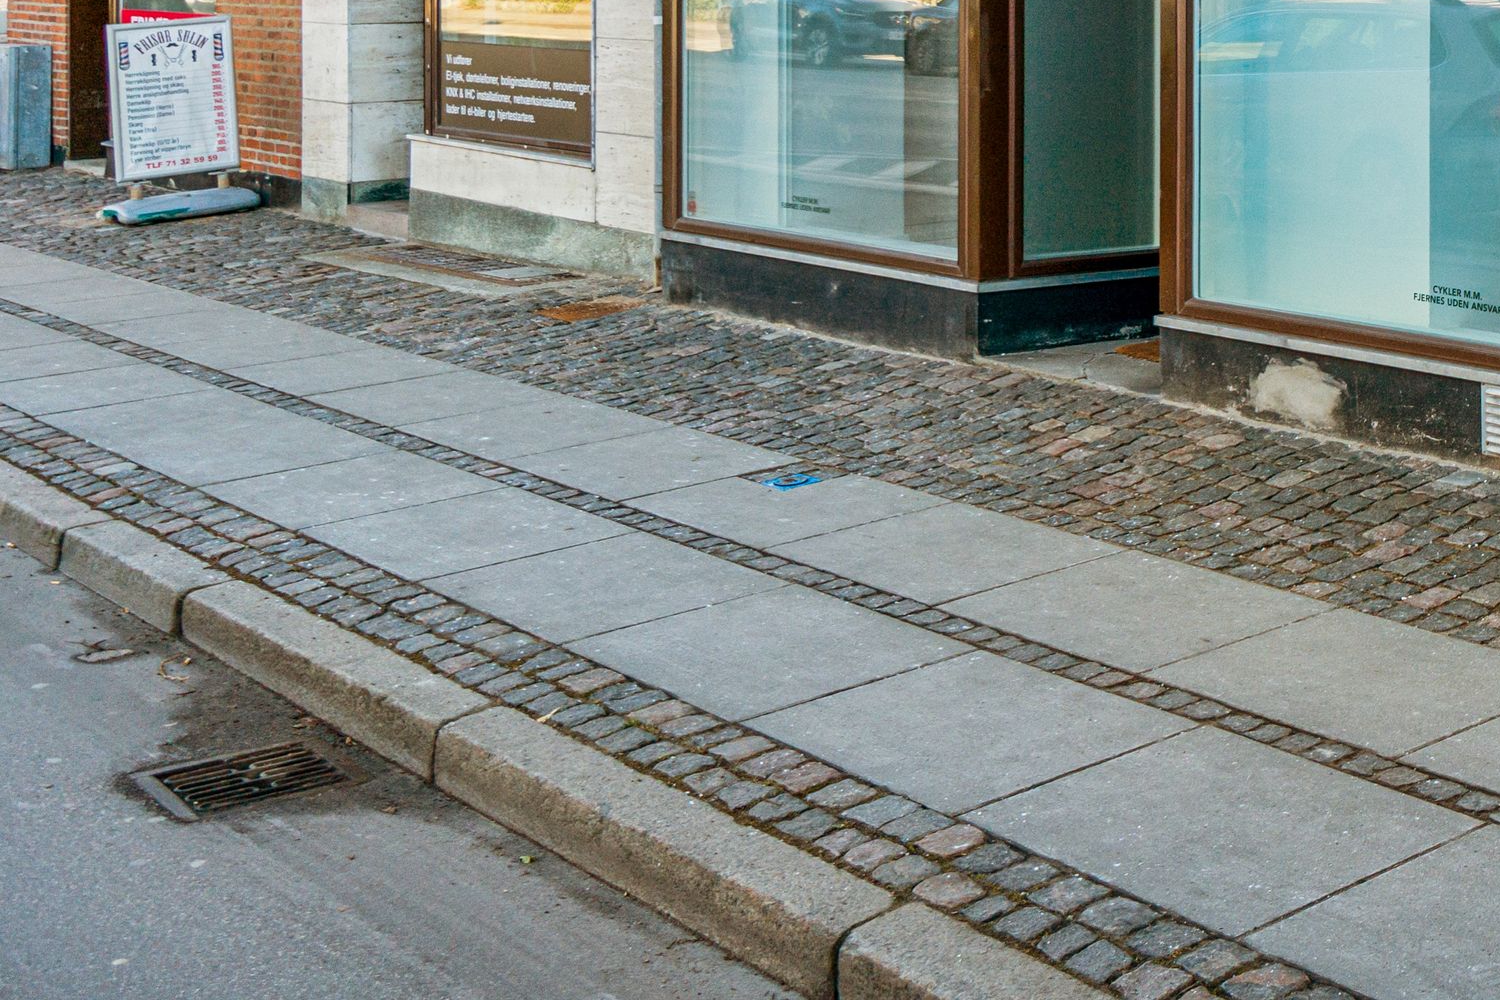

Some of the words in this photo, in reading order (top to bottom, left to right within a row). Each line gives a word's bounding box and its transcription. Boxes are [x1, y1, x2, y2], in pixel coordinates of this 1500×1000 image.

[208, 154, 218, 162] 59
[1413, 292, 1446, 305] FJERNES
[1447, 298, 1469, 309] UDEN
[1432, 285, 1462, 298] CYKLER
[1463, 289, 1483, 301] M.M.
